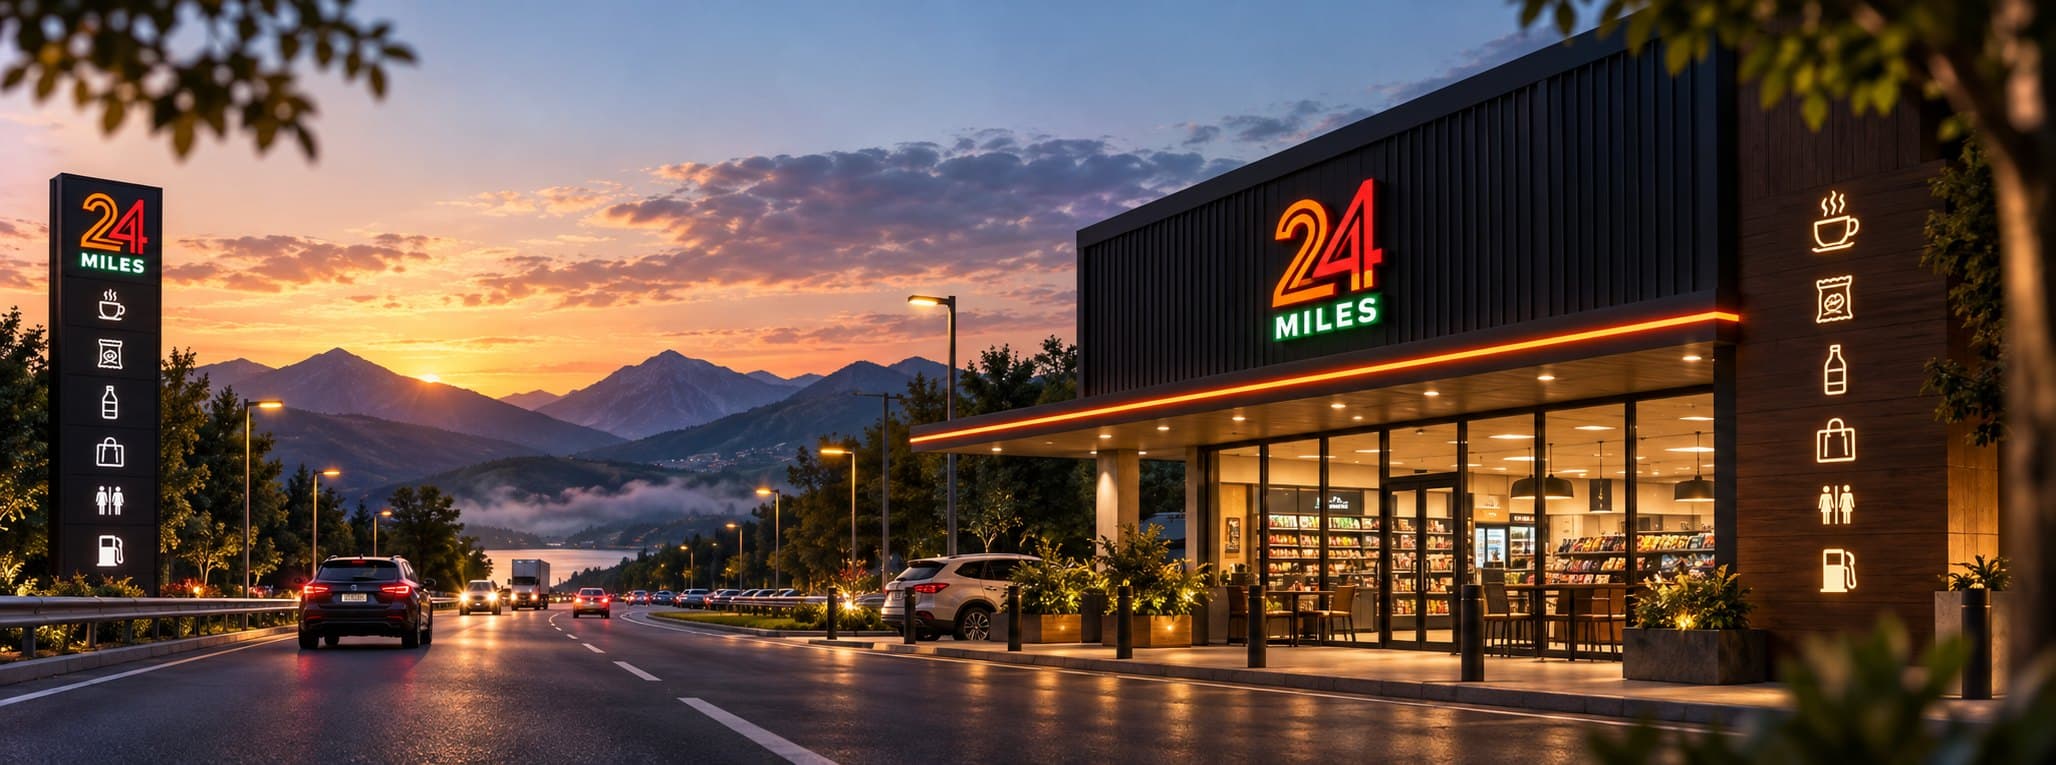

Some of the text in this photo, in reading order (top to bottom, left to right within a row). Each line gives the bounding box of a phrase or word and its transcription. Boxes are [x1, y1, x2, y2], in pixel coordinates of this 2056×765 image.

[80, 192, 149, 254] 24
[1272, 178, 1382, 308] 24
[81, 252, 145, 274] MILES
[1275, 297, 1377, 340] MILES
